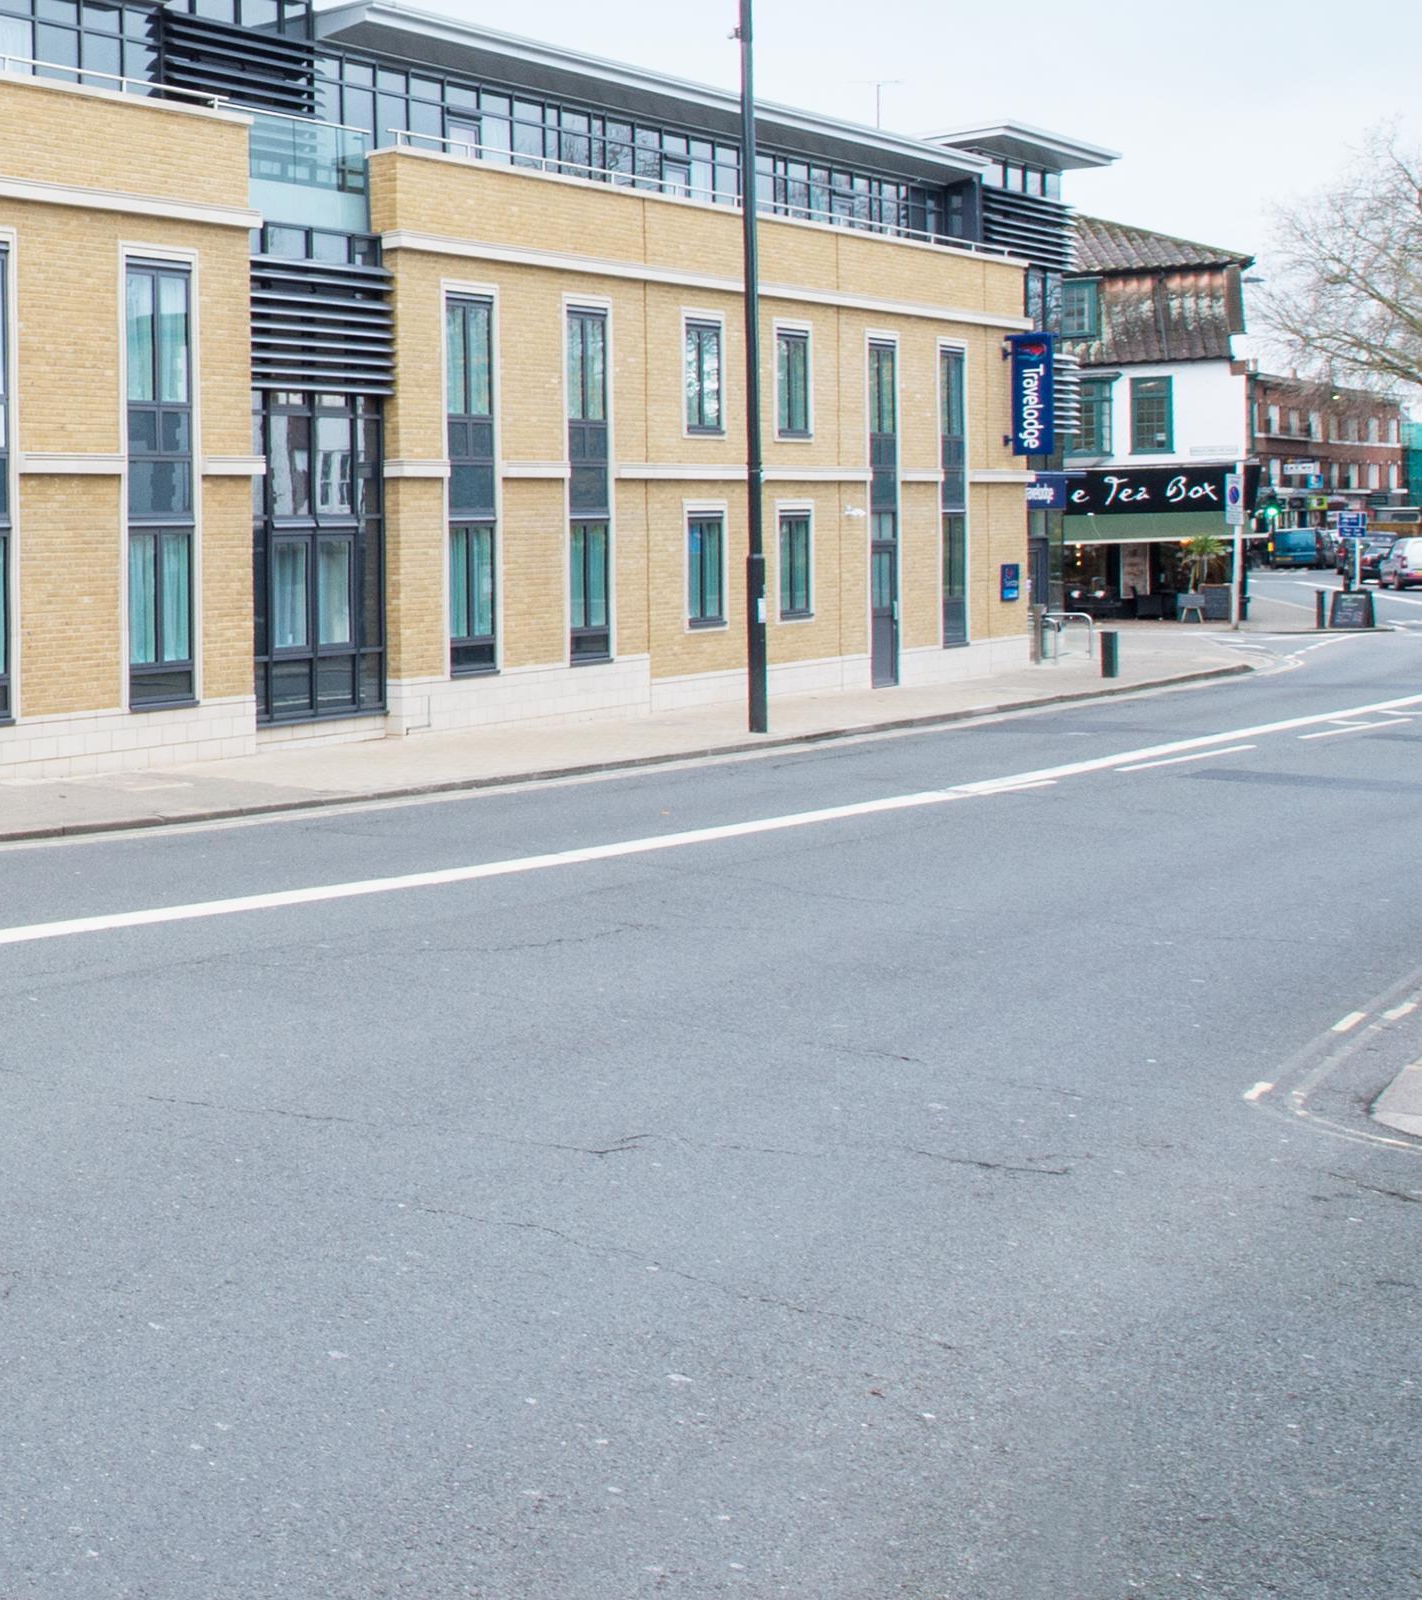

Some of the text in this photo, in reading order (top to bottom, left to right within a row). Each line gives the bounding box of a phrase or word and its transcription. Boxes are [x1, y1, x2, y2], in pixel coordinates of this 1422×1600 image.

[1019, 363, 1044, 449] Travelodge
[1103, 476, 1150, 506] Tea
[1166, 475, 1219, 503] Box
